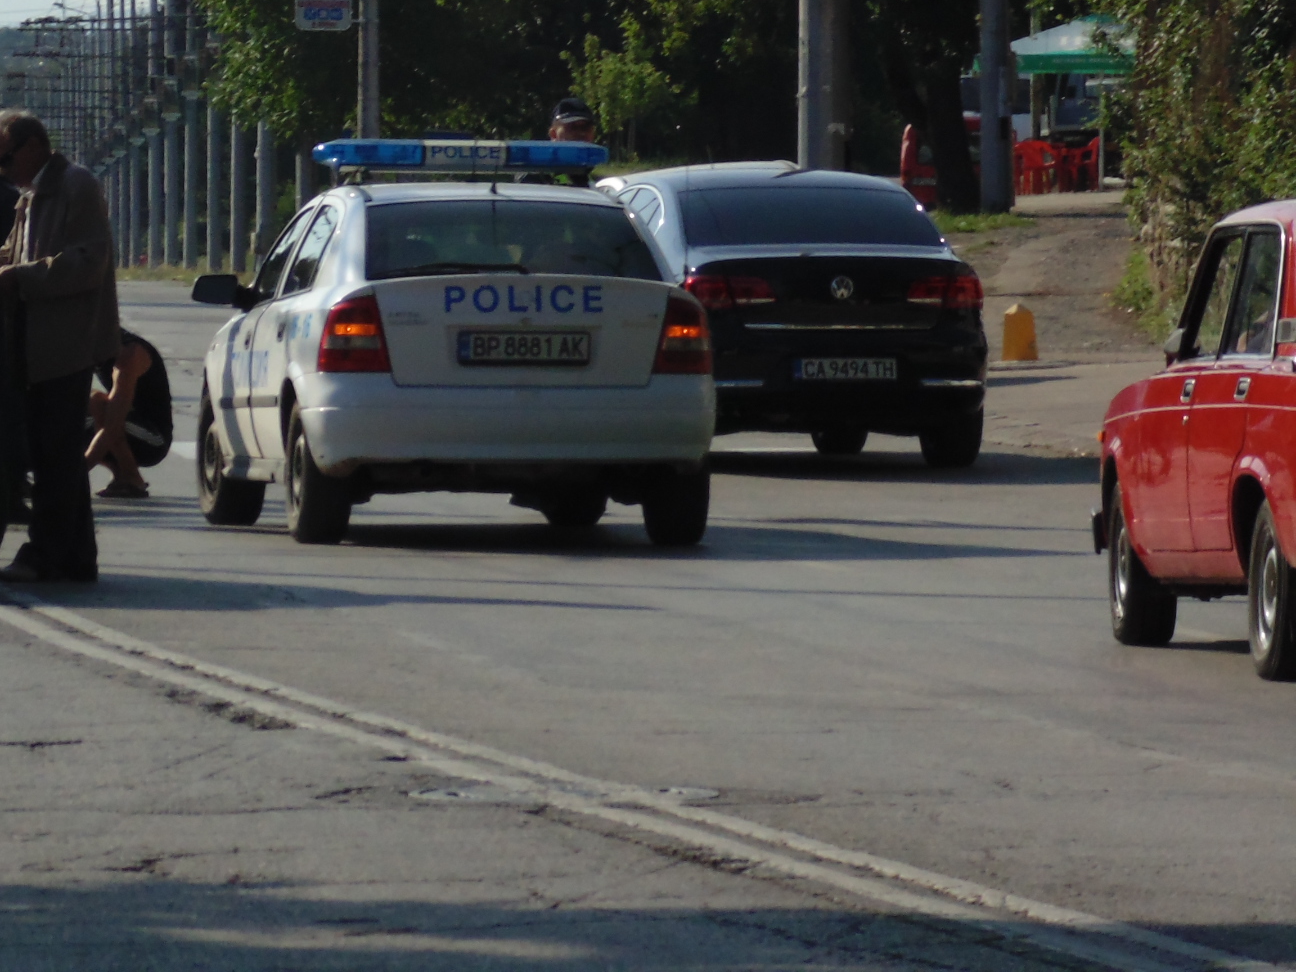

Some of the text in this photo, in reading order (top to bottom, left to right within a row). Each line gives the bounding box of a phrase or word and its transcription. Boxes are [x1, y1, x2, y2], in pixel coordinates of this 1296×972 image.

[431, 146, 500, 159] POLICE
[444, 285, 604, 313] POLICE
[504, 336, 552, 357] 8881
[558, 336, 584, 357] AK
[805, 361, 894, 377] CA 9494 TH
